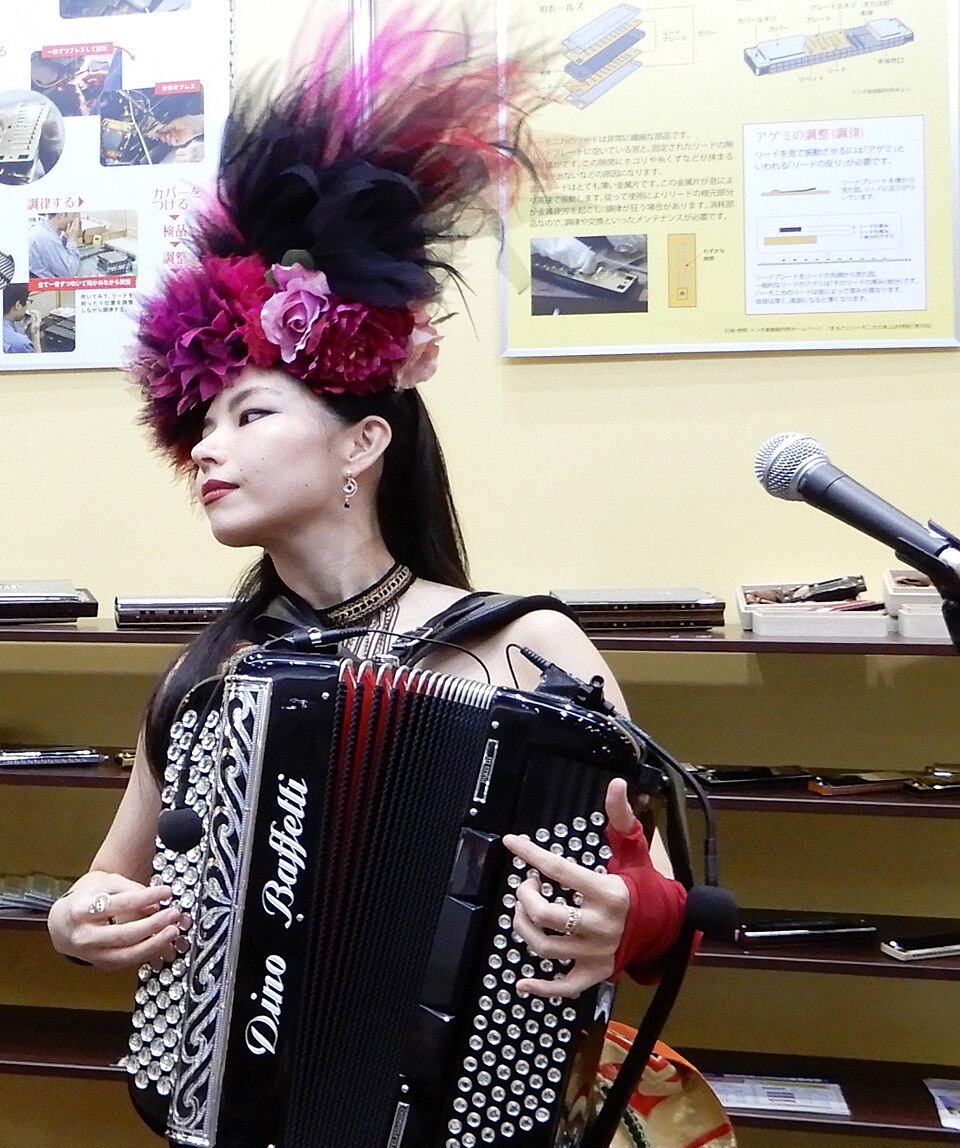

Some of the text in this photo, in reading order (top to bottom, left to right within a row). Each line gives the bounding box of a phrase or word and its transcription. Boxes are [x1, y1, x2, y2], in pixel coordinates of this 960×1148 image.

[152, 184, 201, 200] カバーを
[27, 197, 74, 211] 調律する
[152, 198, 188, 210] つける
[245, 773, 309, 1056] Dino Baffetti
